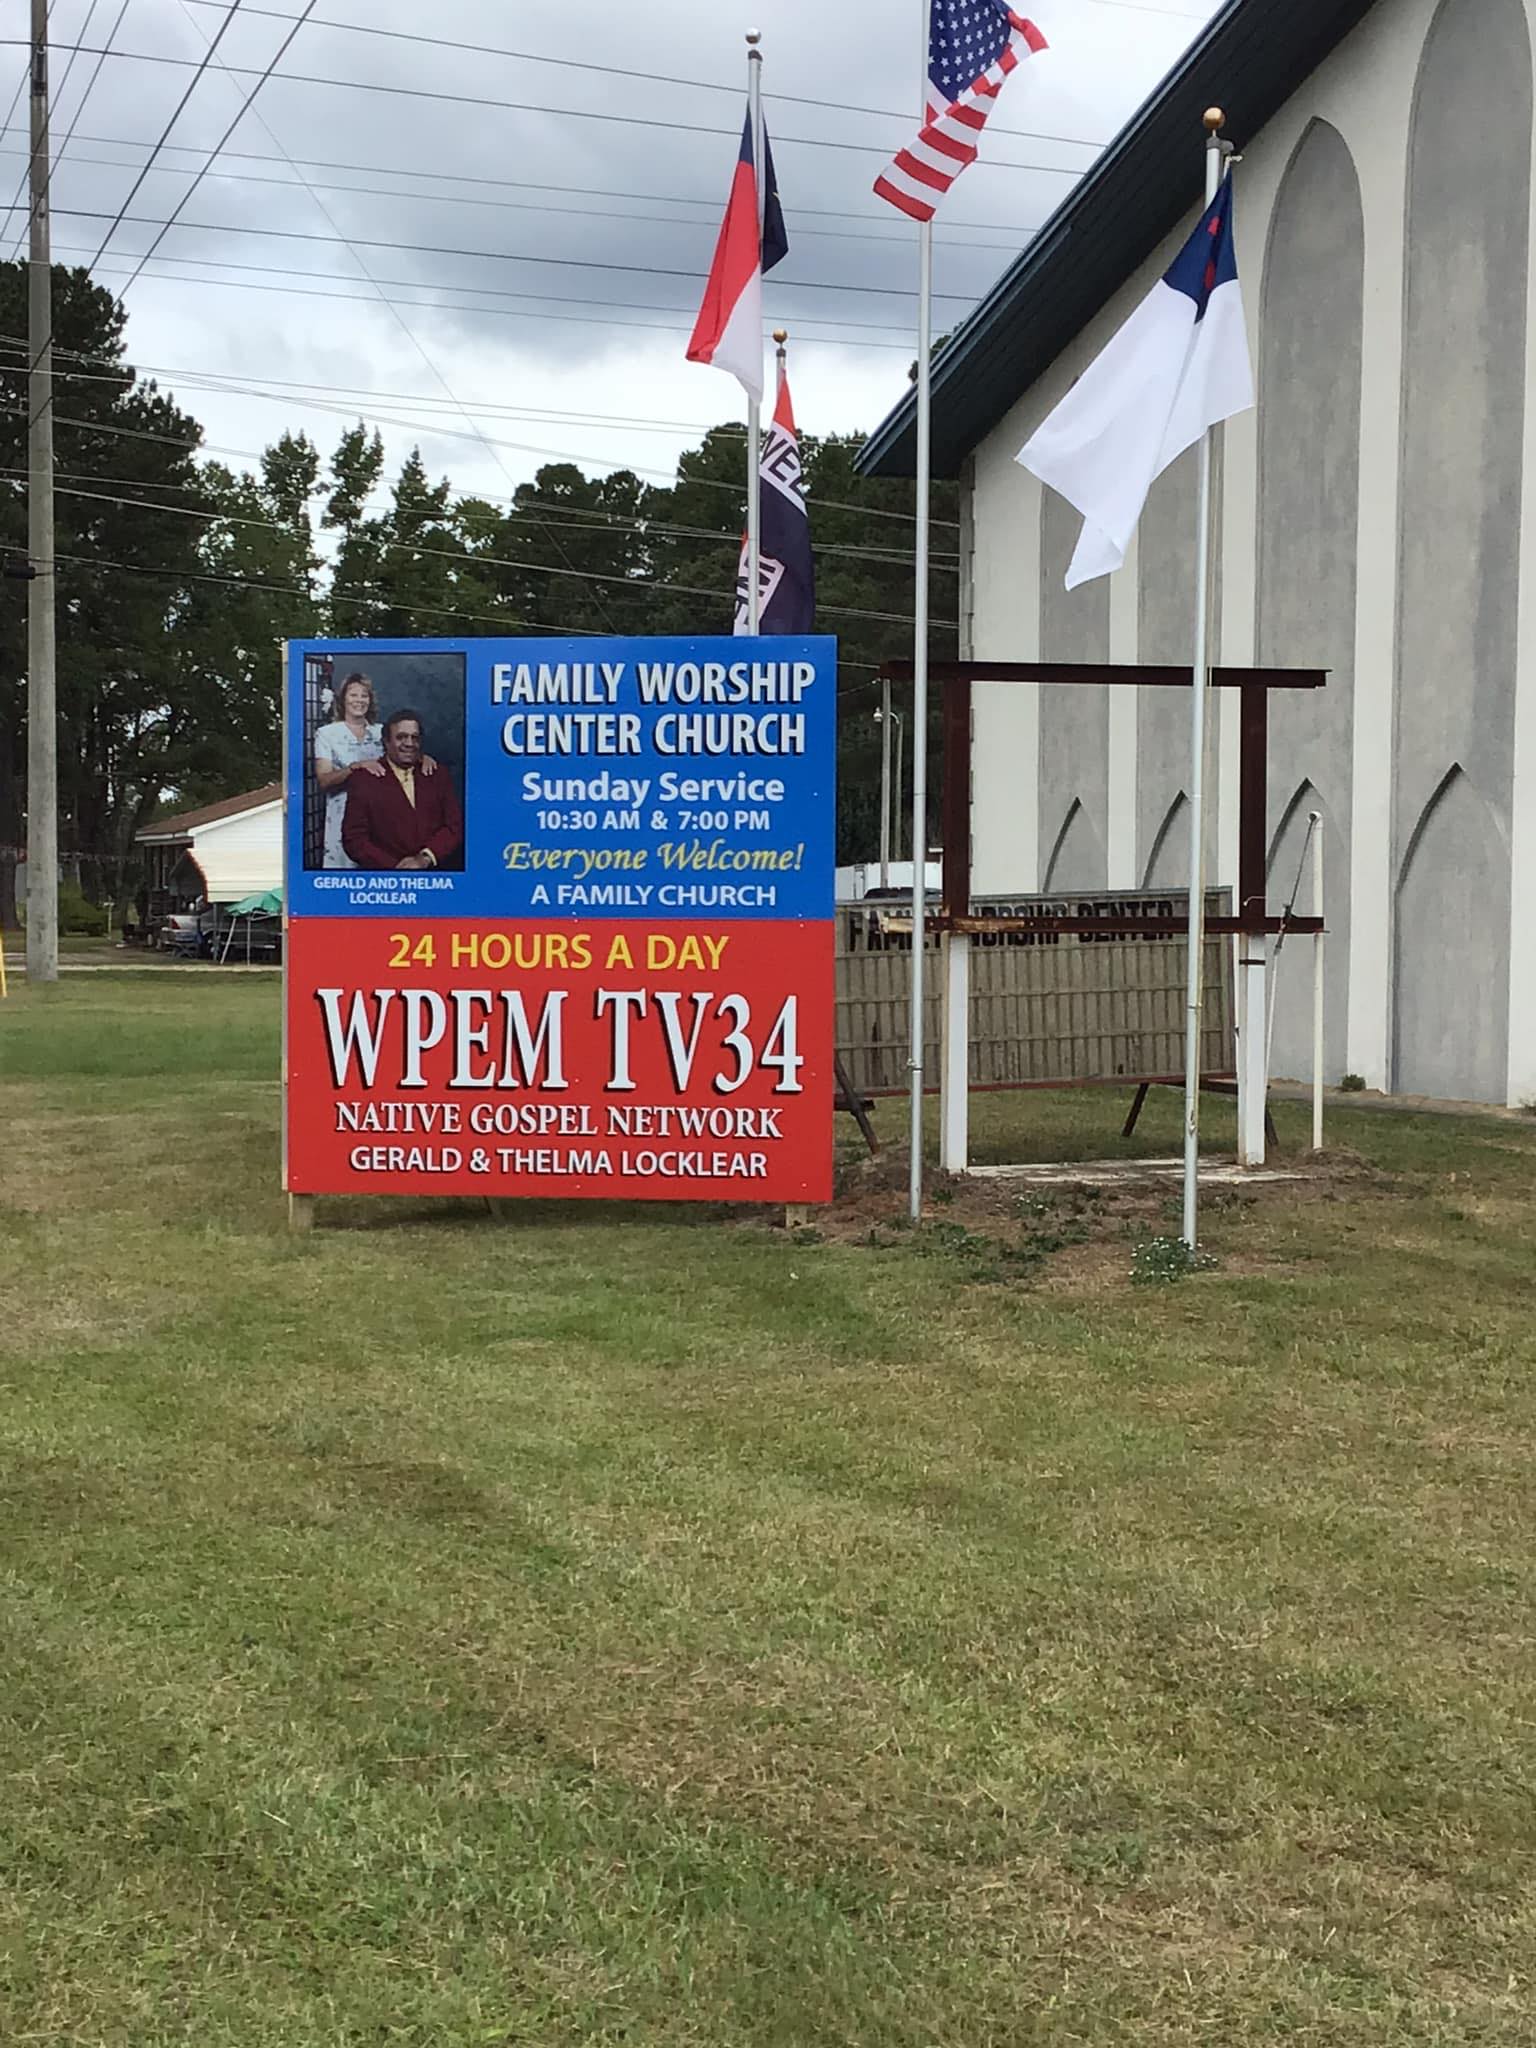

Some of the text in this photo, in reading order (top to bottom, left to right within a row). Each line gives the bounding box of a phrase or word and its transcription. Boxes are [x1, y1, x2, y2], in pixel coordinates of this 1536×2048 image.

[492, 661, 816, 705] FAMILY WORSHIP
[503, 711, 806, 757] CENTER CHURCH
[521, 771, 785, 809] Sunday Service
[536, 810, 770, 831] 10:30 AM & 7:00 PM
[503, 840, 804, 878] Everyone Welcome!
[313, 877, 453, 891] GERALD AND THELMA
[349, 892, 416, 905] LOCKLEAR
[530, 885, 776, 907] A FAMILY CHURCH
[388, 934, 730, 970] 24 HOURS A DAY
[316, 987, 804, 1093] WPEM TV34
[336, 1101, 783, 1140] NATIVE GOSPEL NETWORK
[350, 1146, 768, 1178] GERALD & THELMA LOCKLEAR
